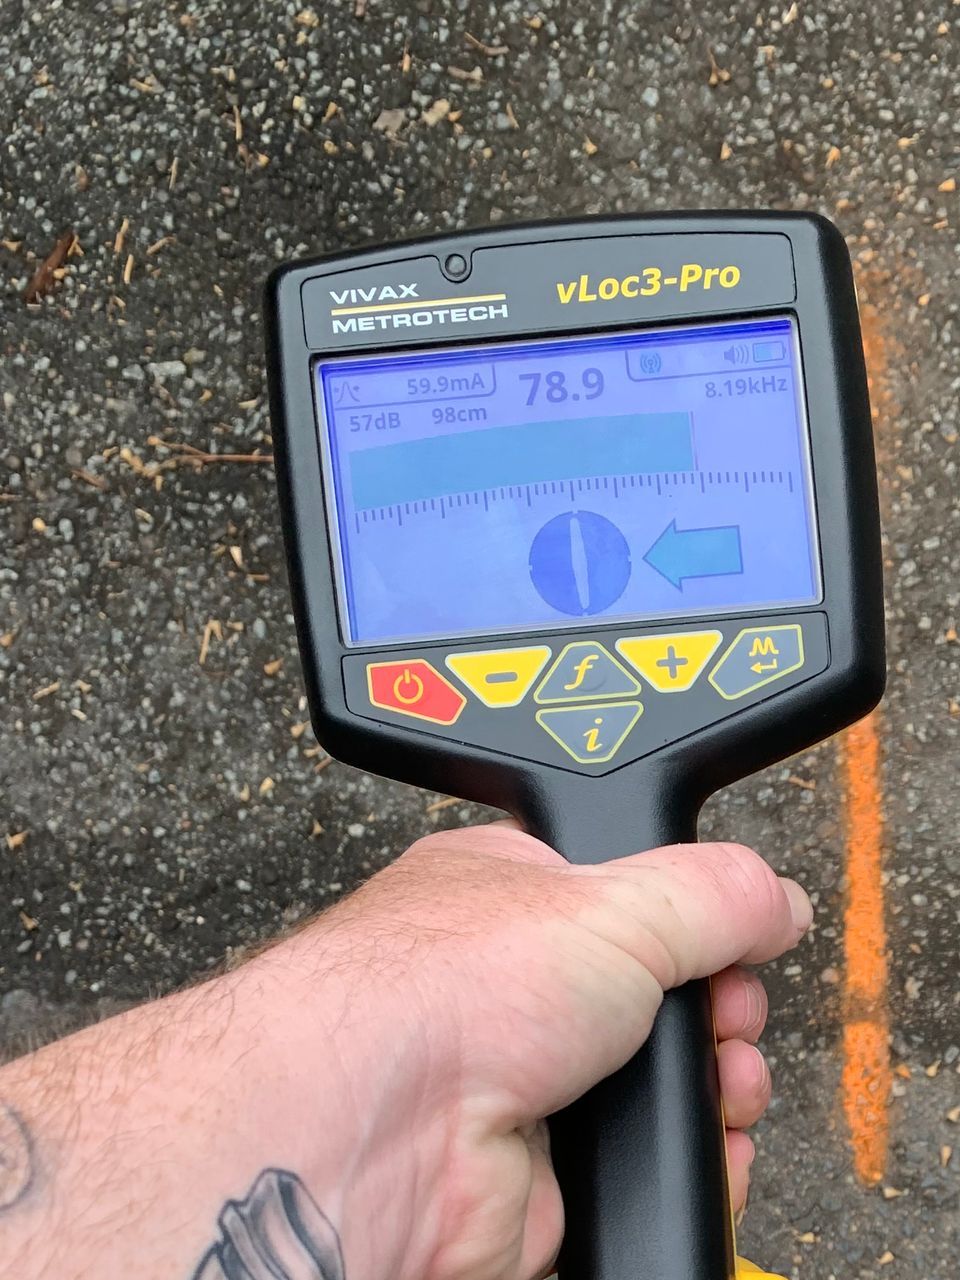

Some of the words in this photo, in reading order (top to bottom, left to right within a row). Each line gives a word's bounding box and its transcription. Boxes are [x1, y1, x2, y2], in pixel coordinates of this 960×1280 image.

[329, 283, 419, 305] VIVAX
[556, 264, 741, 304] vLoc3-Pro
[332, 304, 509, 334] METROTECH
[406, 372, 486, 395] 59.9mA
[518, 367, 605, 406] 78.9
[704, 375, 788, 398] 8.19kHz
[349, 412, 401, 432] 57dB
[431, 407, 488, 425] 98cm
